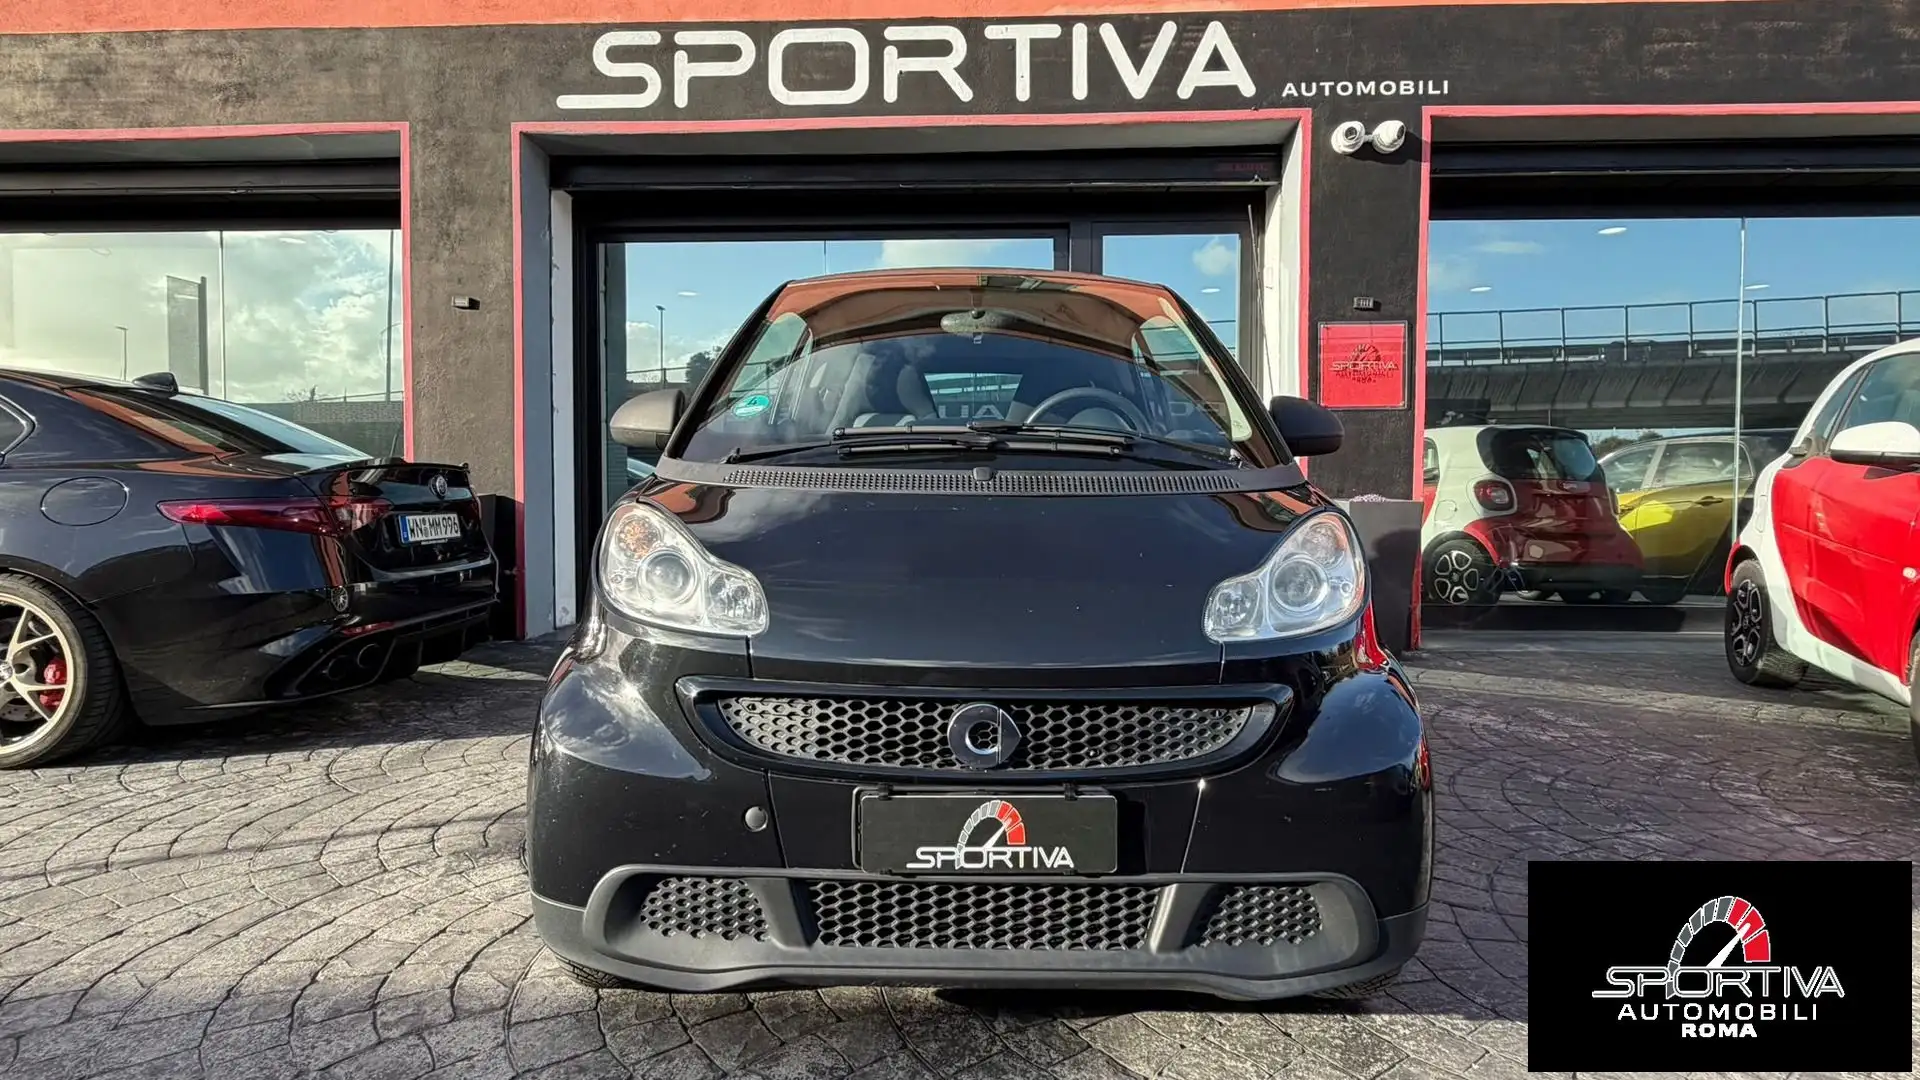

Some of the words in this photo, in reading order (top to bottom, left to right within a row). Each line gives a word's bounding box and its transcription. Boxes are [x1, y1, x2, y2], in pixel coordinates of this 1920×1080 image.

[556, 20, 1256, 109] SPORTIVA
[1281, 80, 1450, 97] AUTOMOBILI
[1328, 360, 1397, 371] SPORTIVA
[906, 846, 1075, 869] SPORTIVA
